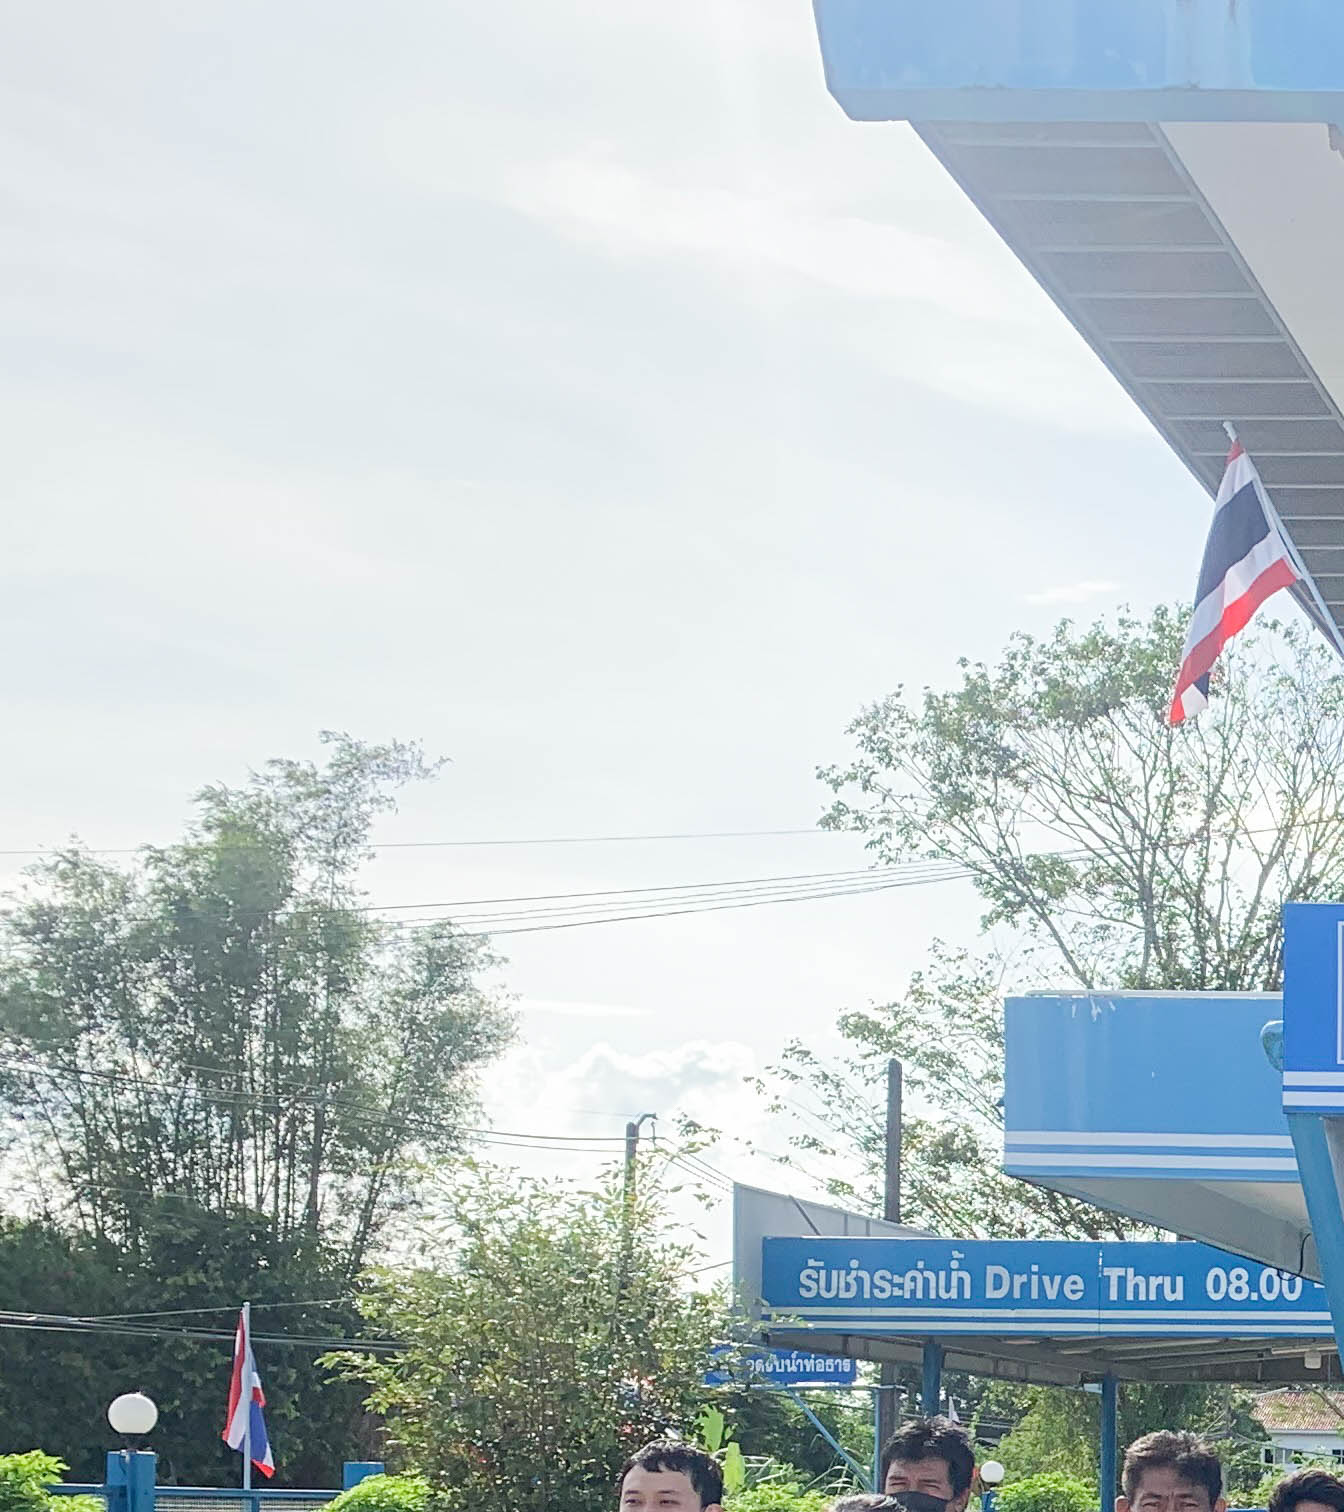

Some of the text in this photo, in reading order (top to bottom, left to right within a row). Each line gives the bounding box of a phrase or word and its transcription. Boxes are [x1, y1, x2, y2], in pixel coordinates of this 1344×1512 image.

[799, 1250, 972, 1301] รับชำระค่าน้ำ
[985, 1265, 1085, 1301] Drive
[1102, 1266, 1184, 1301] Thru
[1205, 1266, 1303, 1301] 08.00
